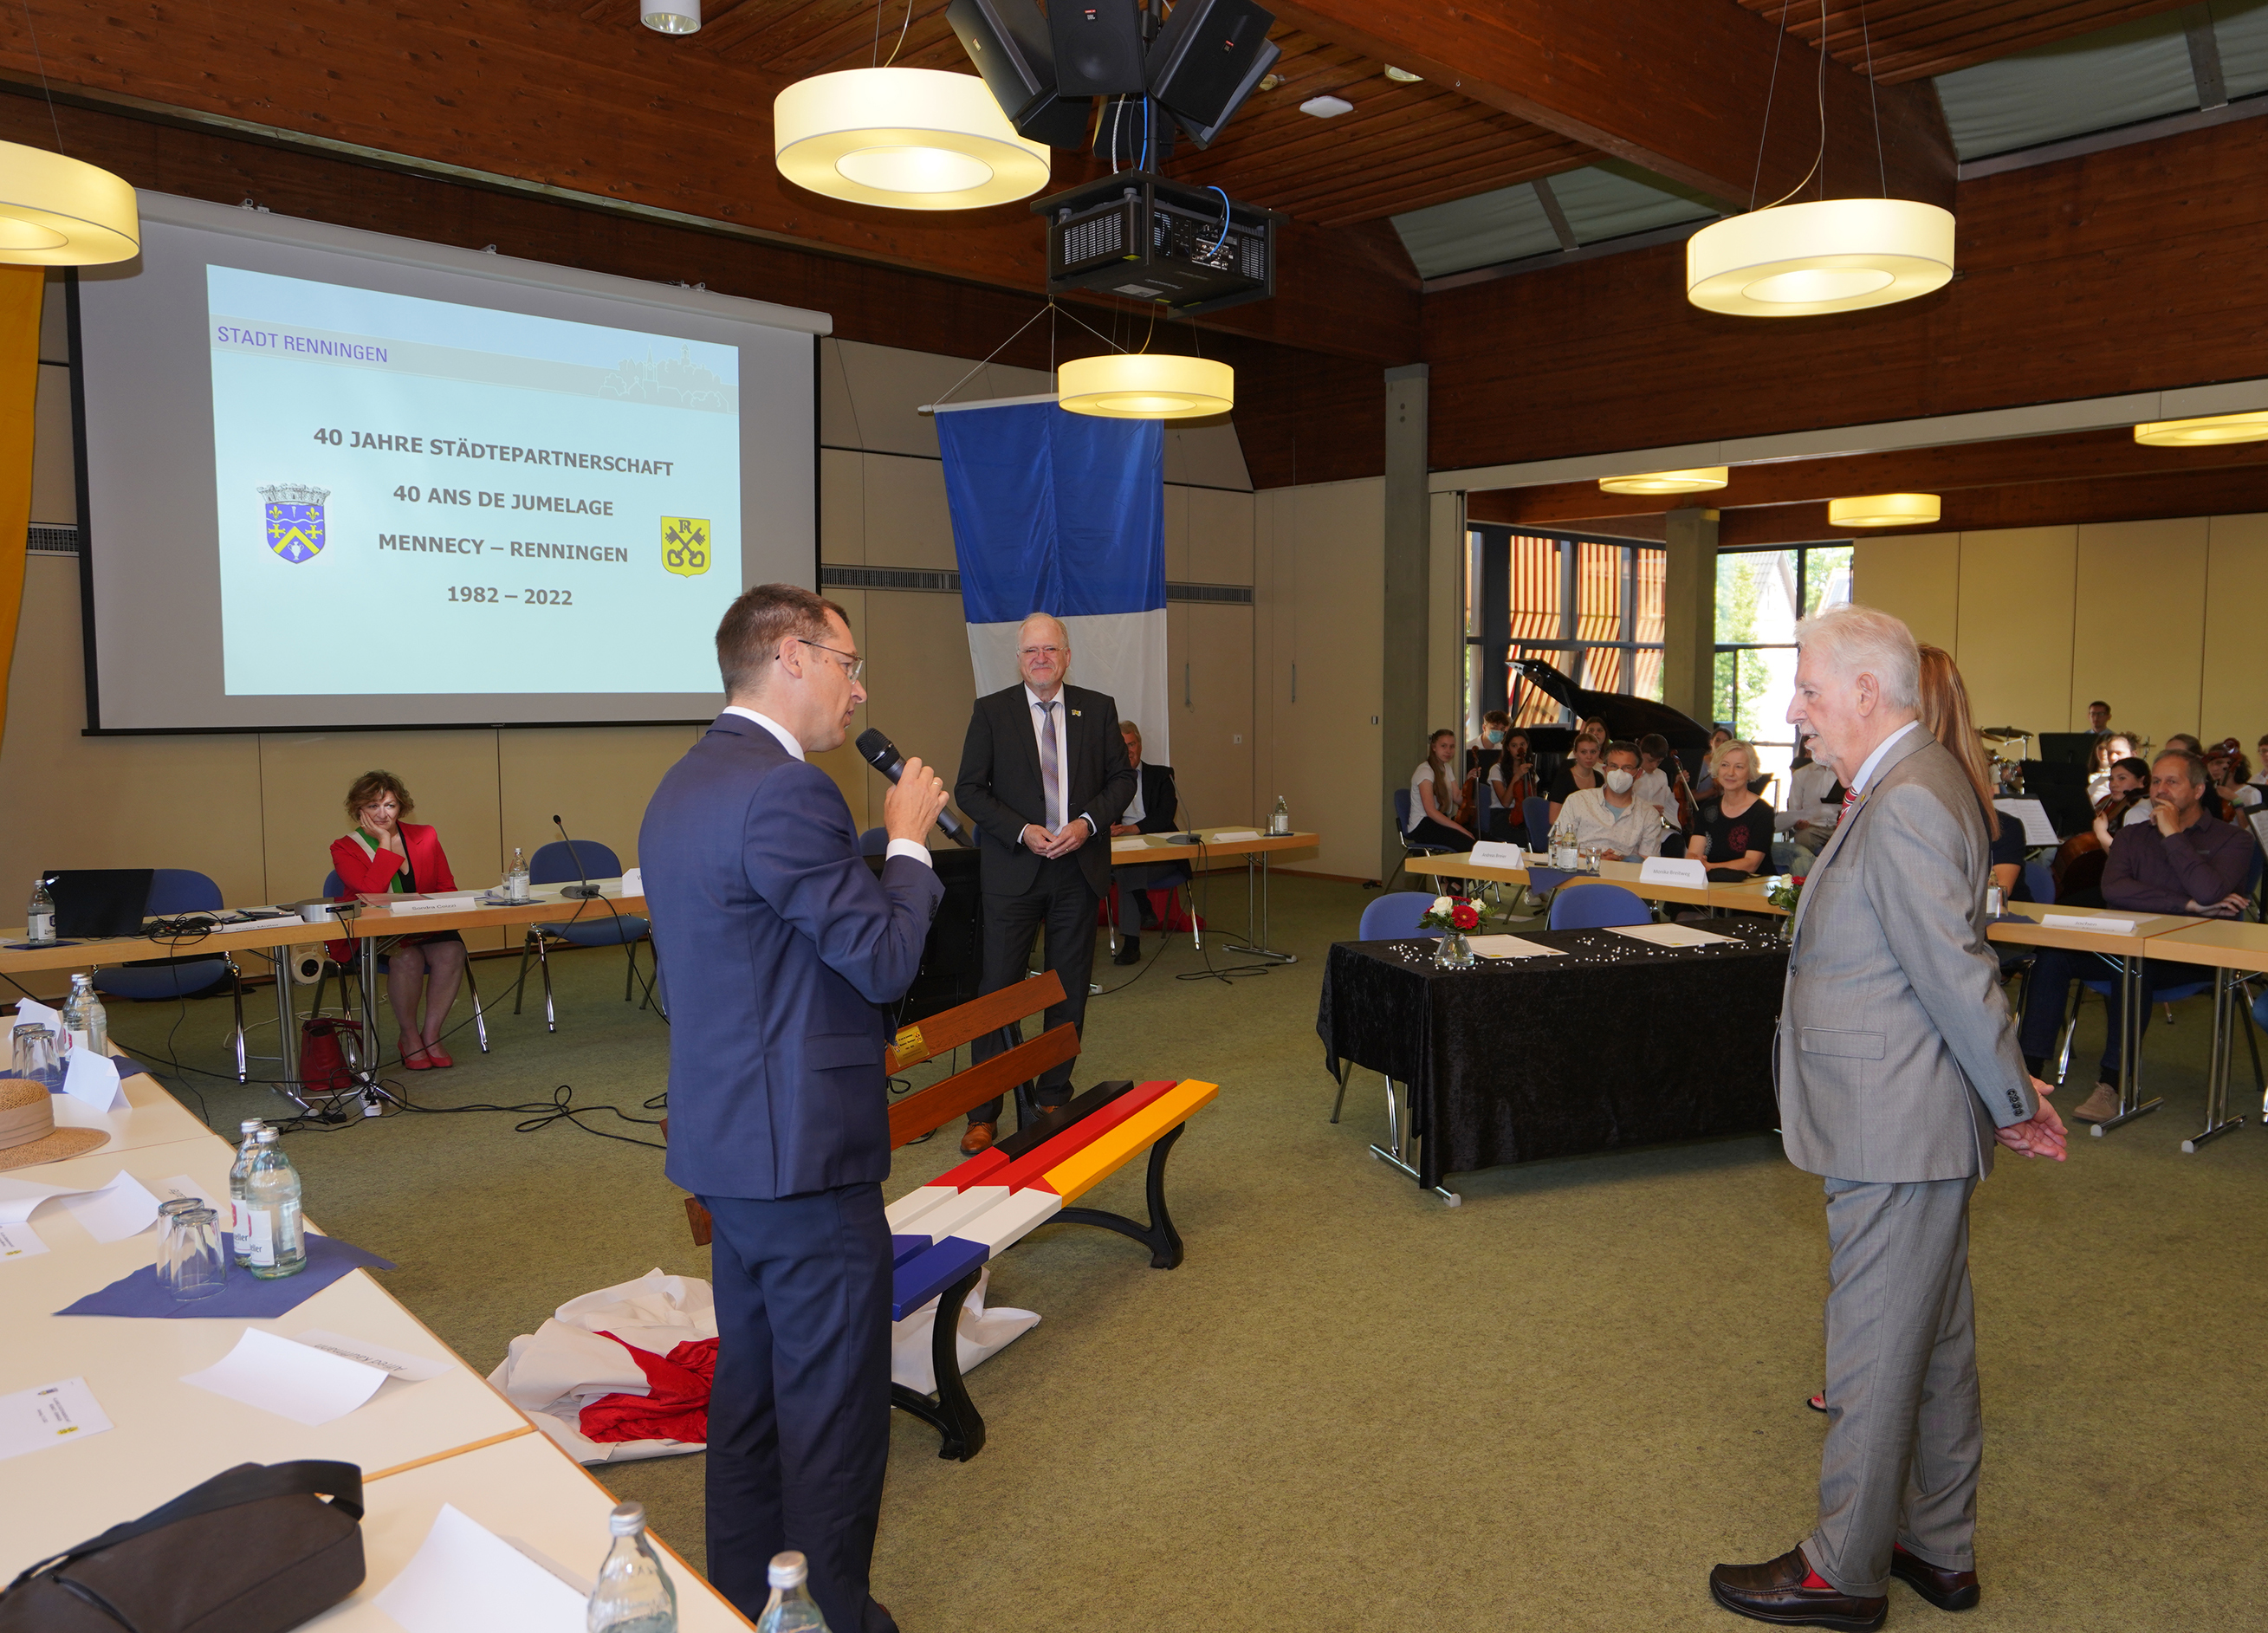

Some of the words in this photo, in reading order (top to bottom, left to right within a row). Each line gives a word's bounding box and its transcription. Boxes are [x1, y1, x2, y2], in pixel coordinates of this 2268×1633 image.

[217, 326, 279, 348] STADT
[283, 335, 387, 363] RENNINGEN
[314, 427, 343, 446] 40
[349, 431, 424, 454] JAHRE
[430, 437, 674, 476] STÄDTEPARTNERSCHAFT
[393, 484, 421, 502] 40
[427, 488, 472, 506] ANS
[478, 491, 505, 509] DE
[511, 494, 613, 516] JUMELAGE
[379, 533, 485, 554] MENNECY
[510, 541, 628, 562] RENNINGEN
[447, 586, 499, 603] 1982
[524, 588, 573, 606] 2022
